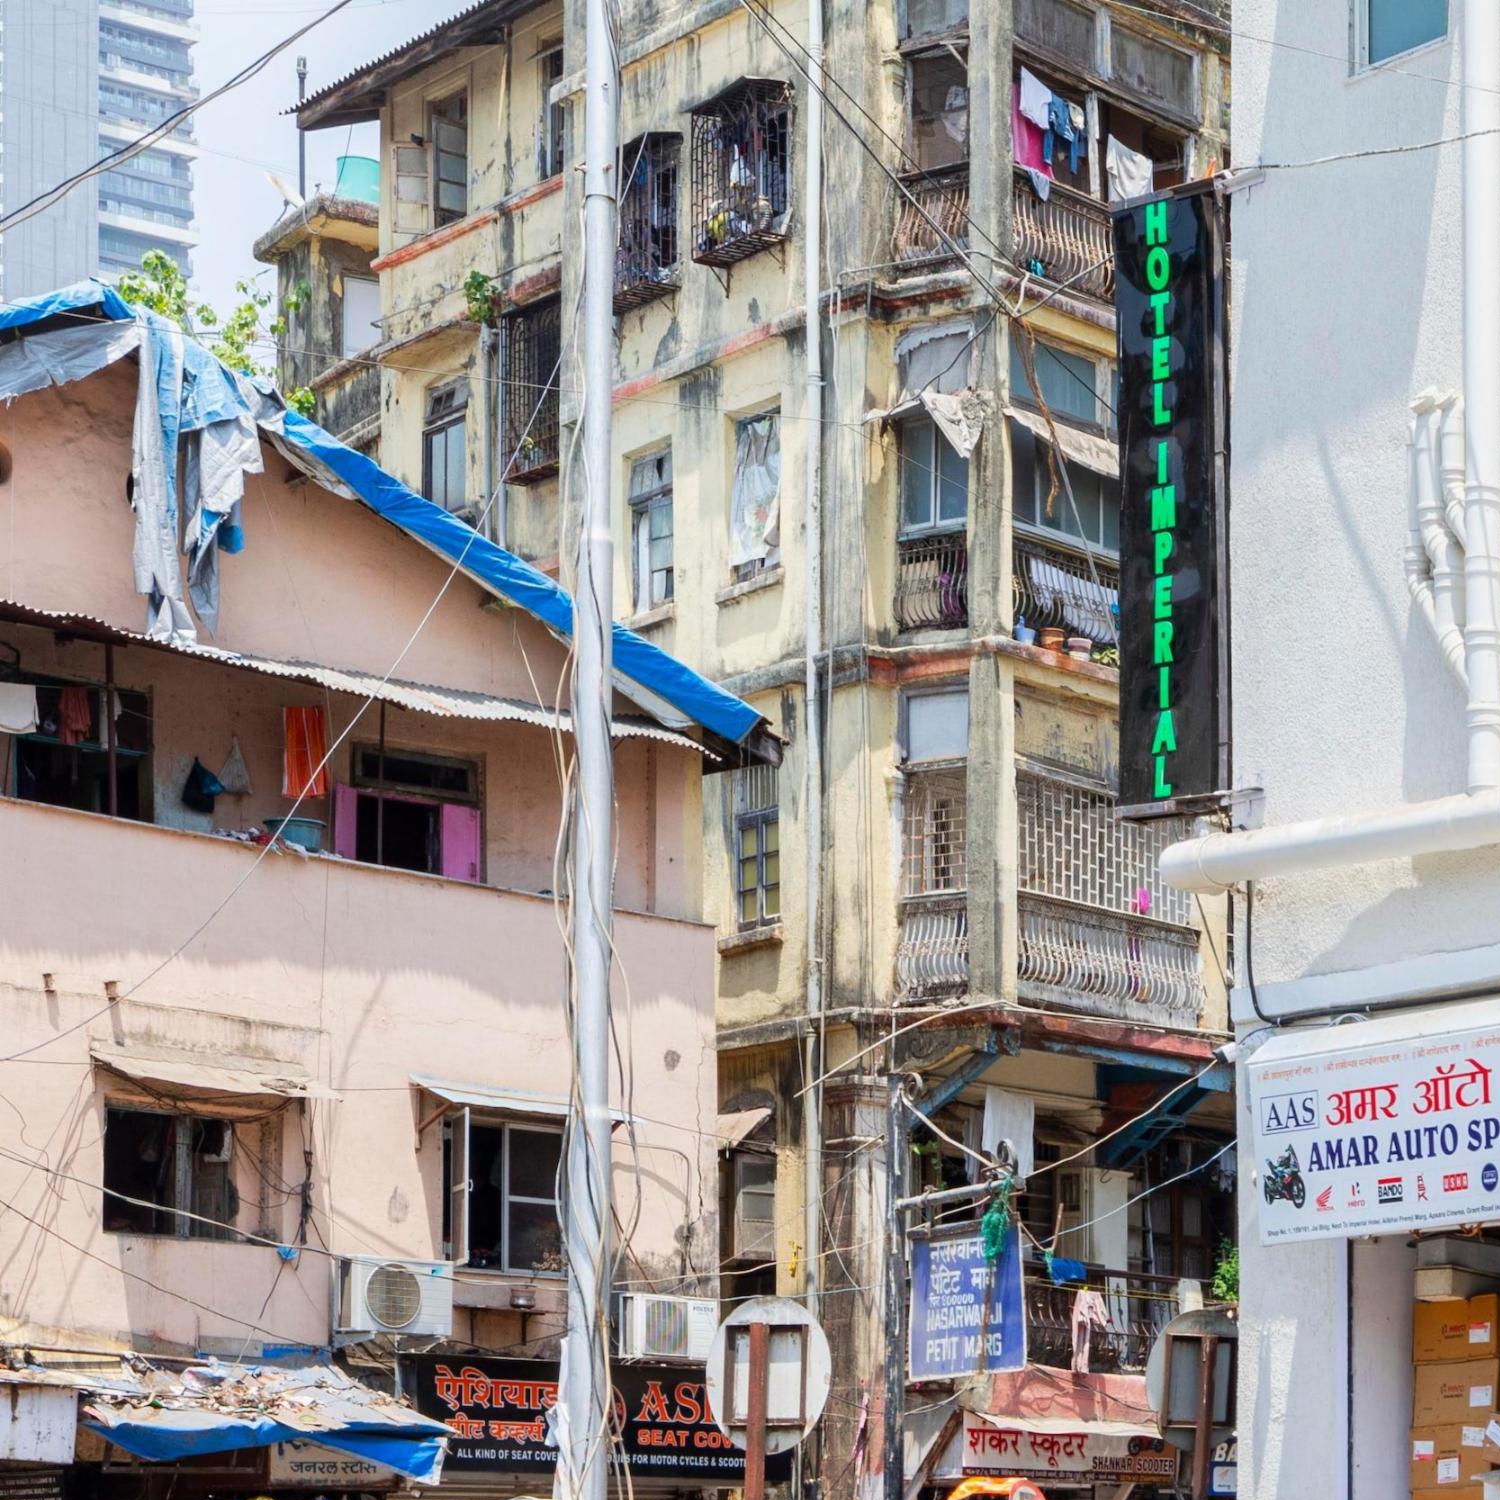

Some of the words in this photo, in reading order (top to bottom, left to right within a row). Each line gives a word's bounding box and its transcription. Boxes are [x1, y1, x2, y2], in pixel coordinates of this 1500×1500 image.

[1144, 202, 1171, 427] HOTEL
[1150, 442, 1177, 798] IMPERIAL
[1325, 1083, 1399, 1126] अमर
[1412, 1058, 1493, 1115] ऑटो
[1265, 1097, 1316, 1131] AAS
[1307, 1134, 1379, 1173] AMAR
[1387, 1123, 1458, 1163] AUTO
[1377, 1183, 1403, 1198] BANDO
[926, 1302, 1003, 1332] NASARWAJI
[926, 1335, 959, 1362] PETIT
[964, 1333, 1003, 1359] MARG
[637, 1429, 690, 1448] SEAT
[967, 1420, 1023, 1458] शंकर
[1027, 1431, 1088, 1468] स्कूटर
[289, 1460, 338, 1474] जनरल
[457, 1447, 473, 1459] ALL
[475, 1448, 496, 1460] KIND
[498, 1449, 509, 1460] OF
[511, 1450, 532, 1460] SEAT
[632, 1454, 649, 1465] FOR
[650, 1454, 678, 1466] MOTOR
[679, 1455, 709, 1467] CYCLES
[1092, 1455, 1133, 1472] SHANKAR
[1136, 1456, 1175, 1474] SCOOTER
